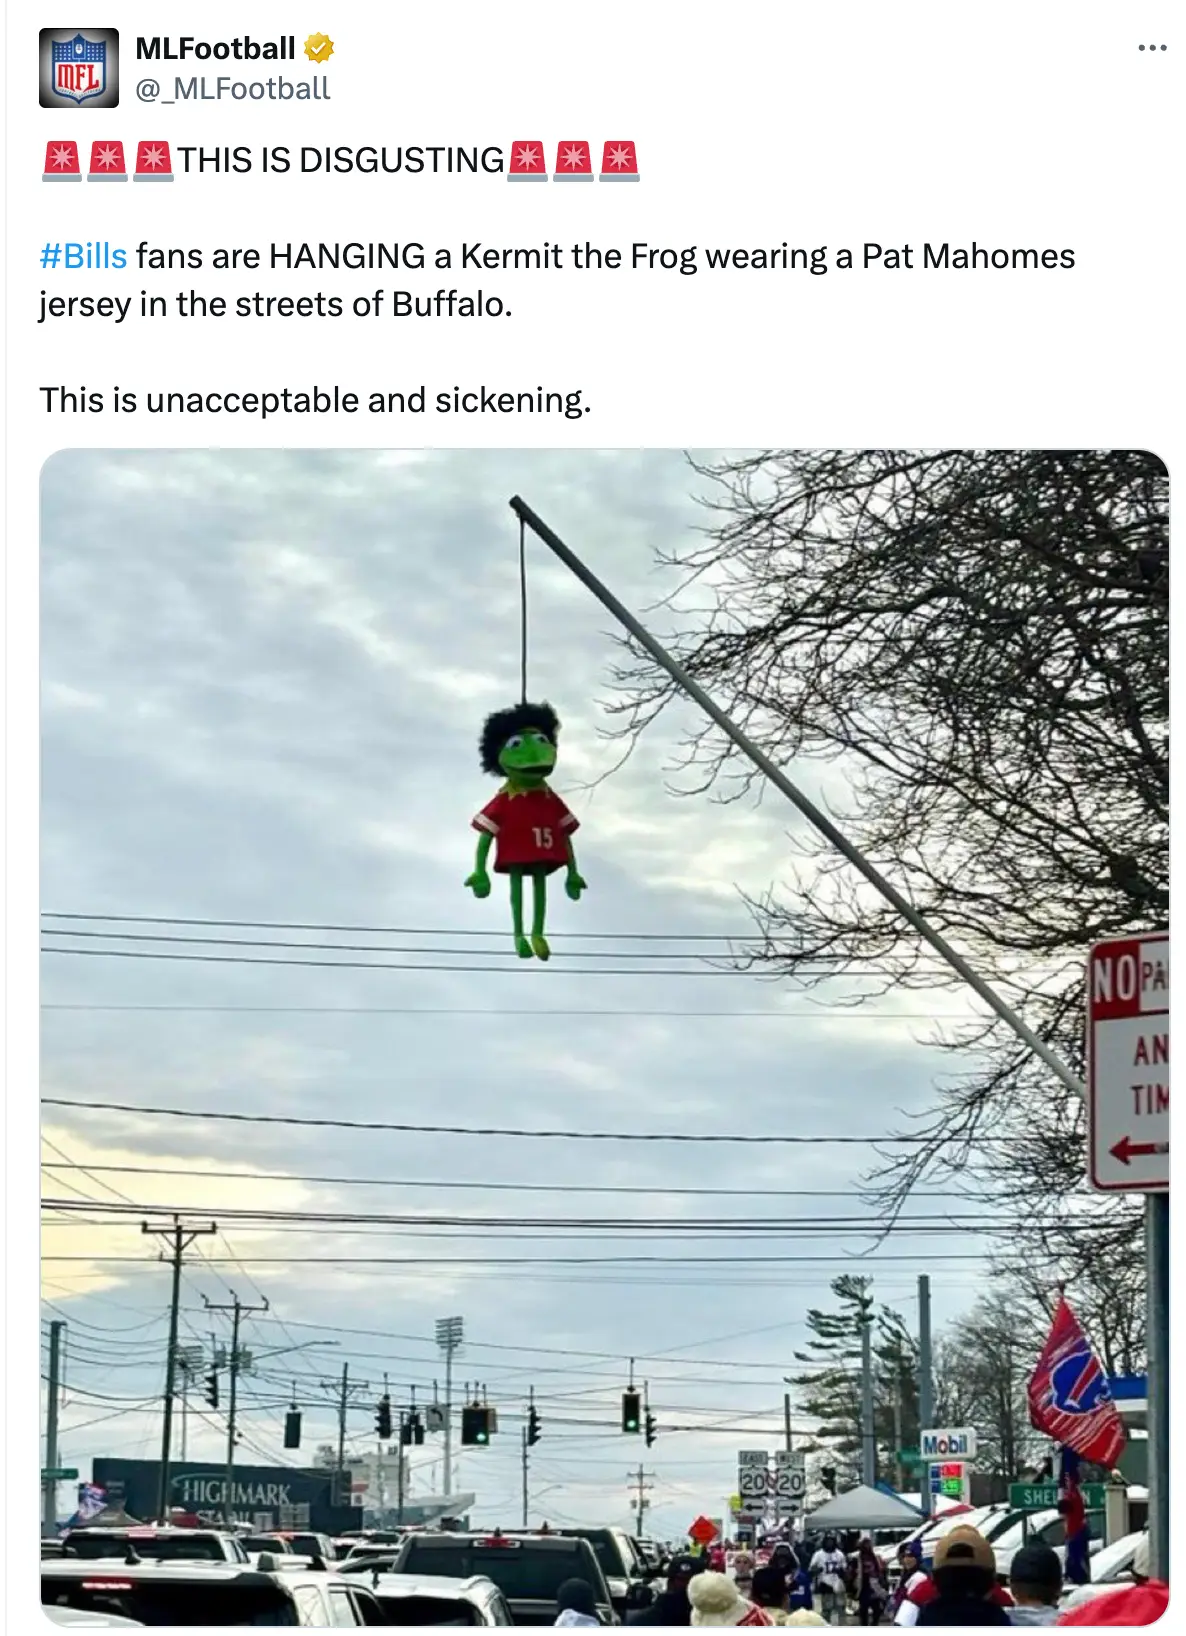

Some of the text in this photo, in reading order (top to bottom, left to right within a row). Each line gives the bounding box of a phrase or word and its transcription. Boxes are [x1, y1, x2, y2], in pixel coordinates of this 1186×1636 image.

[532, 827, 553, 849] 15
[1094, 955, 1169, 1003] NO PA
[924, 1434, 968, 1455] Mobil
[742, 1473, 765, 1490] 20
[779, 1474, 801, 1491] 20
[183, 1479, 291, 1506] HIGHMARK
[1023, 1488, 1092, 1505] SHELN
